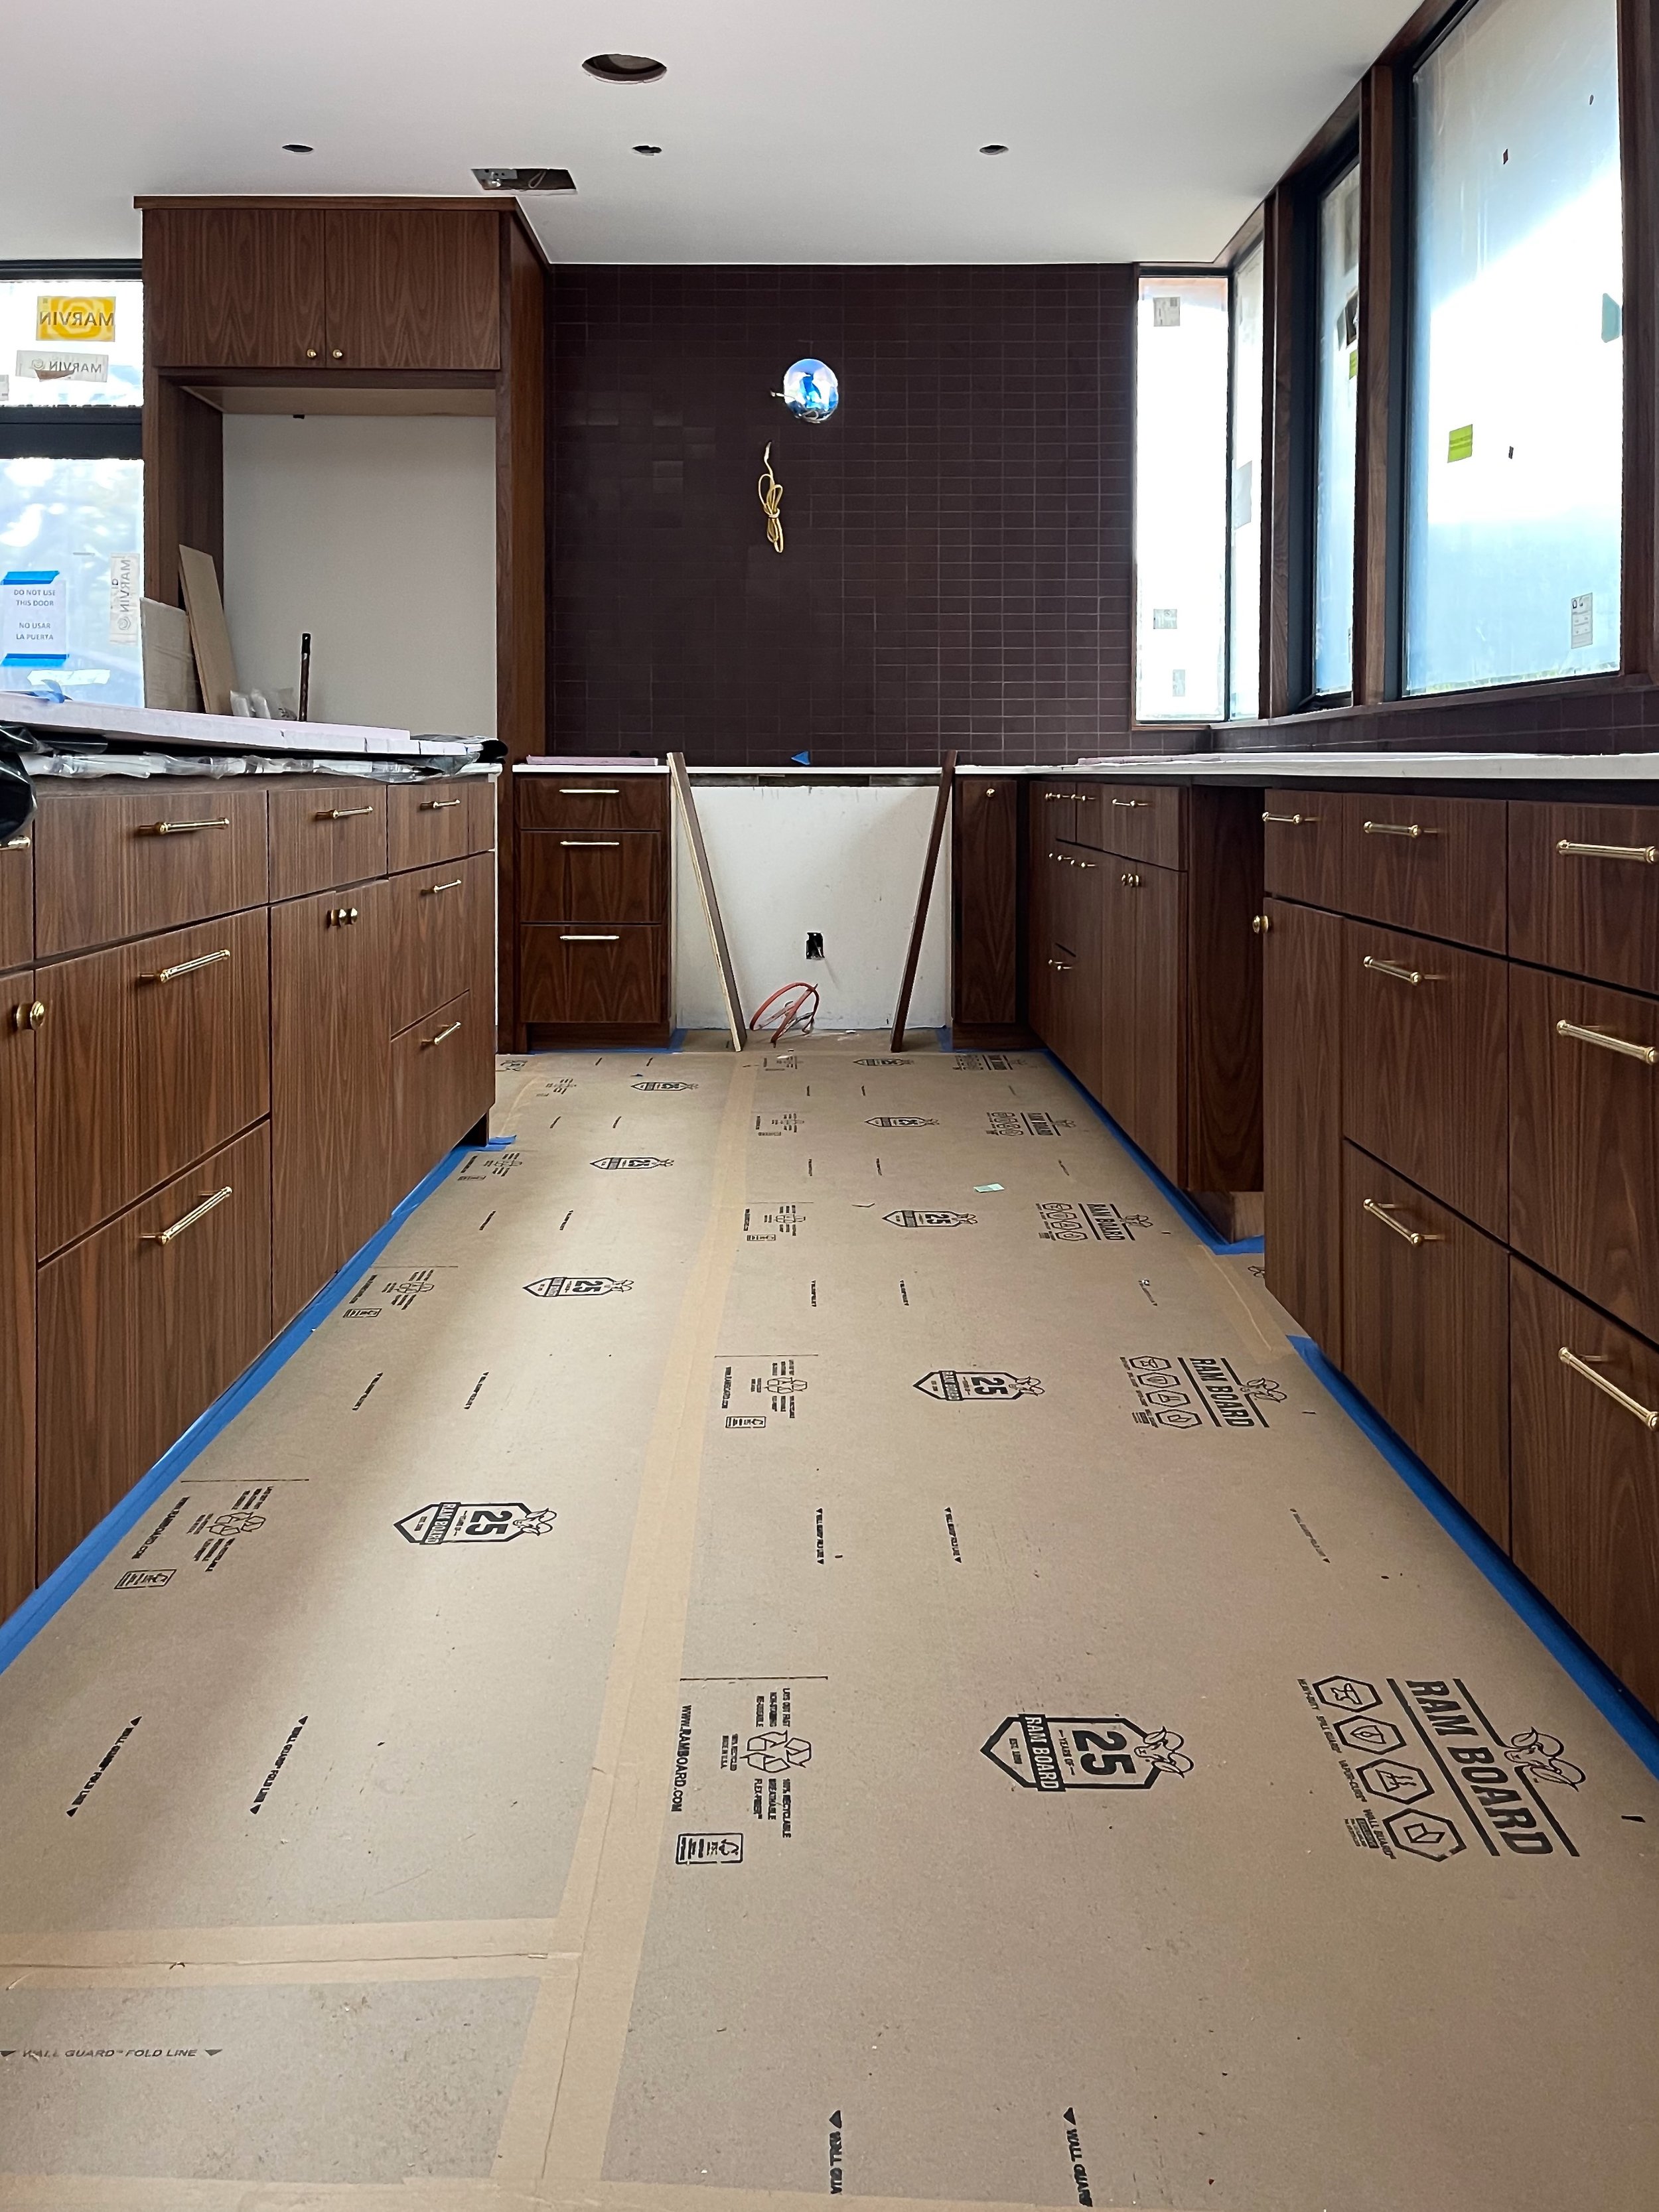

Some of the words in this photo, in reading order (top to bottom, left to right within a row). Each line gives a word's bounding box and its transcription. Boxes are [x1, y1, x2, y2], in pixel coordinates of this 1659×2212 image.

[924, 1213, 952, 1225] 25
[575, 1280, 604, 1293] 25
[1189, 1357, 1228, 1382] RAM
[970, 1377, 1009, 1395] 25
[1205, 1385, 1255, 1427] BOARD
[437, 1503, 457, 1520] RAM
[465, 1510, 513, 1536] 25
[425, 1519, 449, 1544] BOARD
[1025, 1716, 1047, 1744] RAM
[671, 1704, 691, 1812] WWW.RAMBOARD.COM
[1072, 1729, 1137, 1775] 25
[1035, 1746, 1059, 1789] BOARD
[1404, 1679, 1479, 1737] RAM
[1447, 1746, 1553, 1854] BOARD
[125, 2049, 163, 2057] FOLD
[167, 2049, 198, 2057] LINE
[829, 2130, 843, 2166] WALL
[1066, 2128, 1083, 2162] WALL
[830, 2167, 843, 2195] GUA
